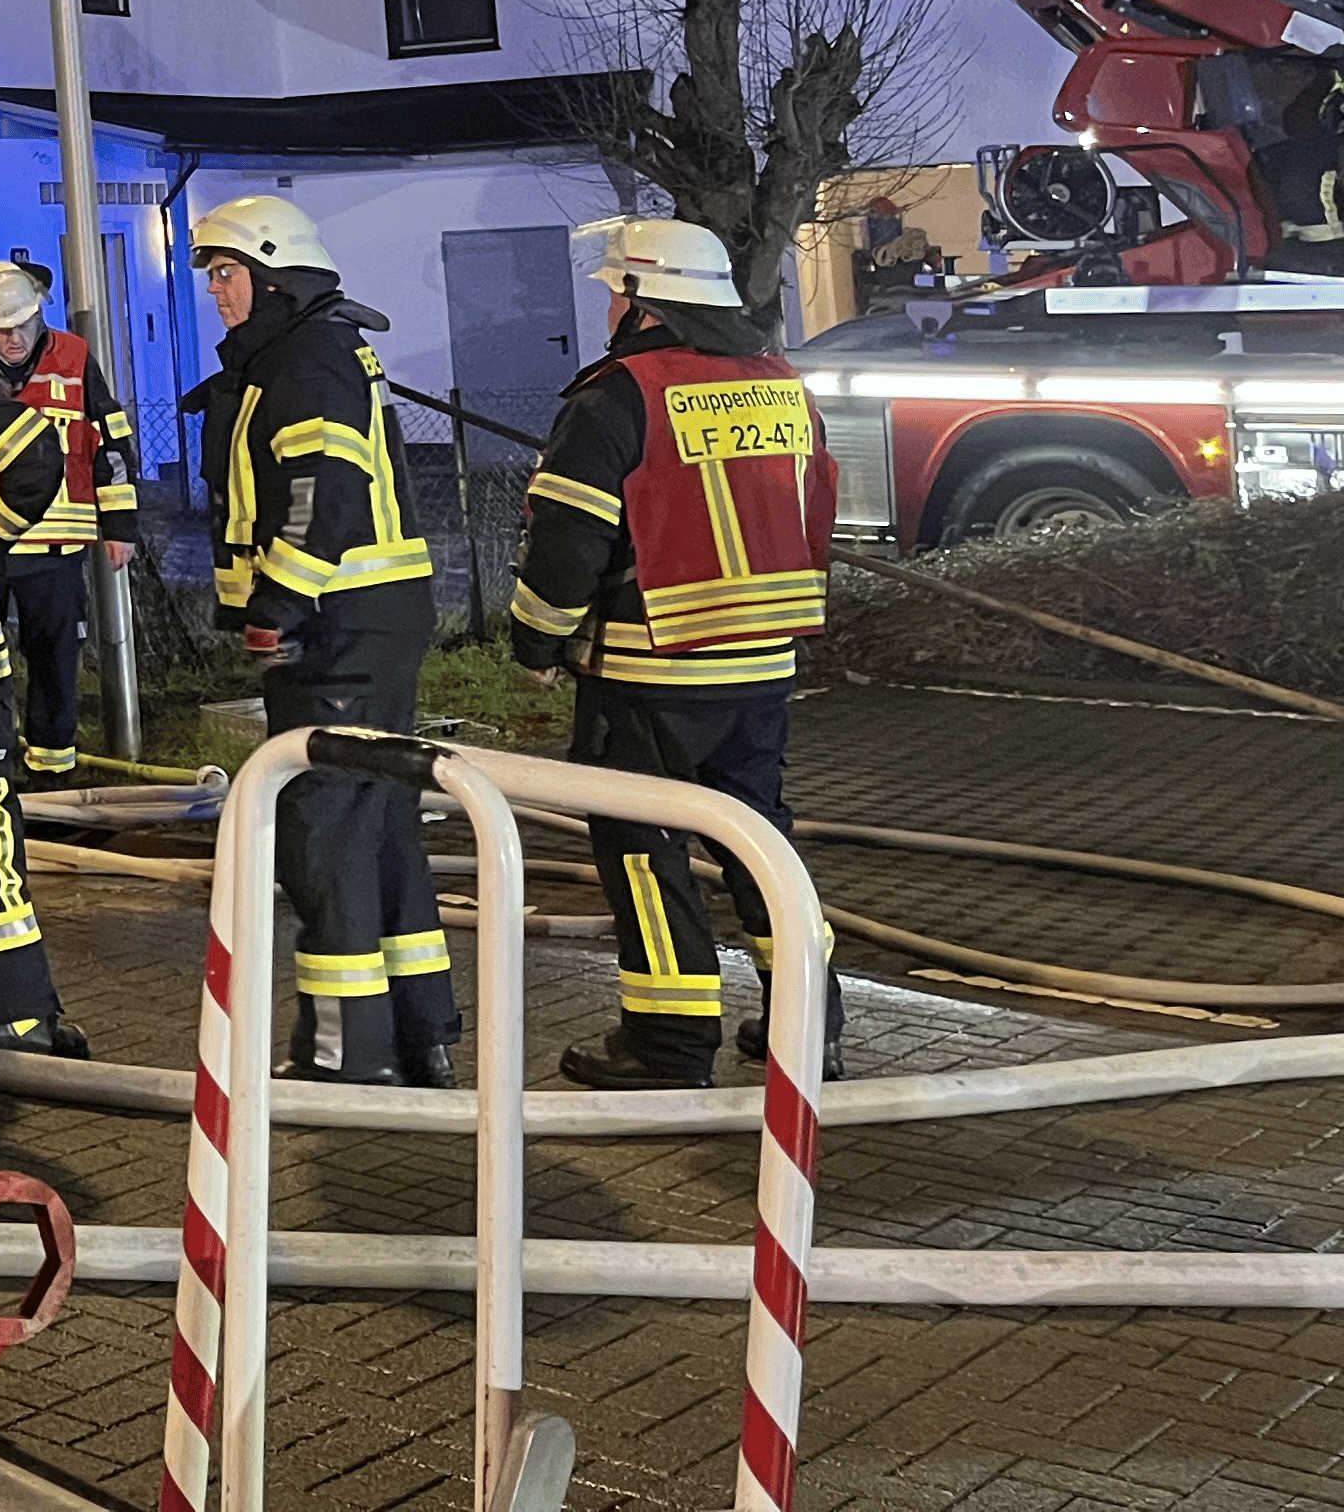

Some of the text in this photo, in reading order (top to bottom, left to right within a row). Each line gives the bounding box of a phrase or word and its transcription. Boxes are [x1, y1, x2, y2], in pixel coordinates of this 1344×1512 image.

[670, 384, 801, 416] Gruppenführer
[680, 423, 811, 458] LF 22-47-1
